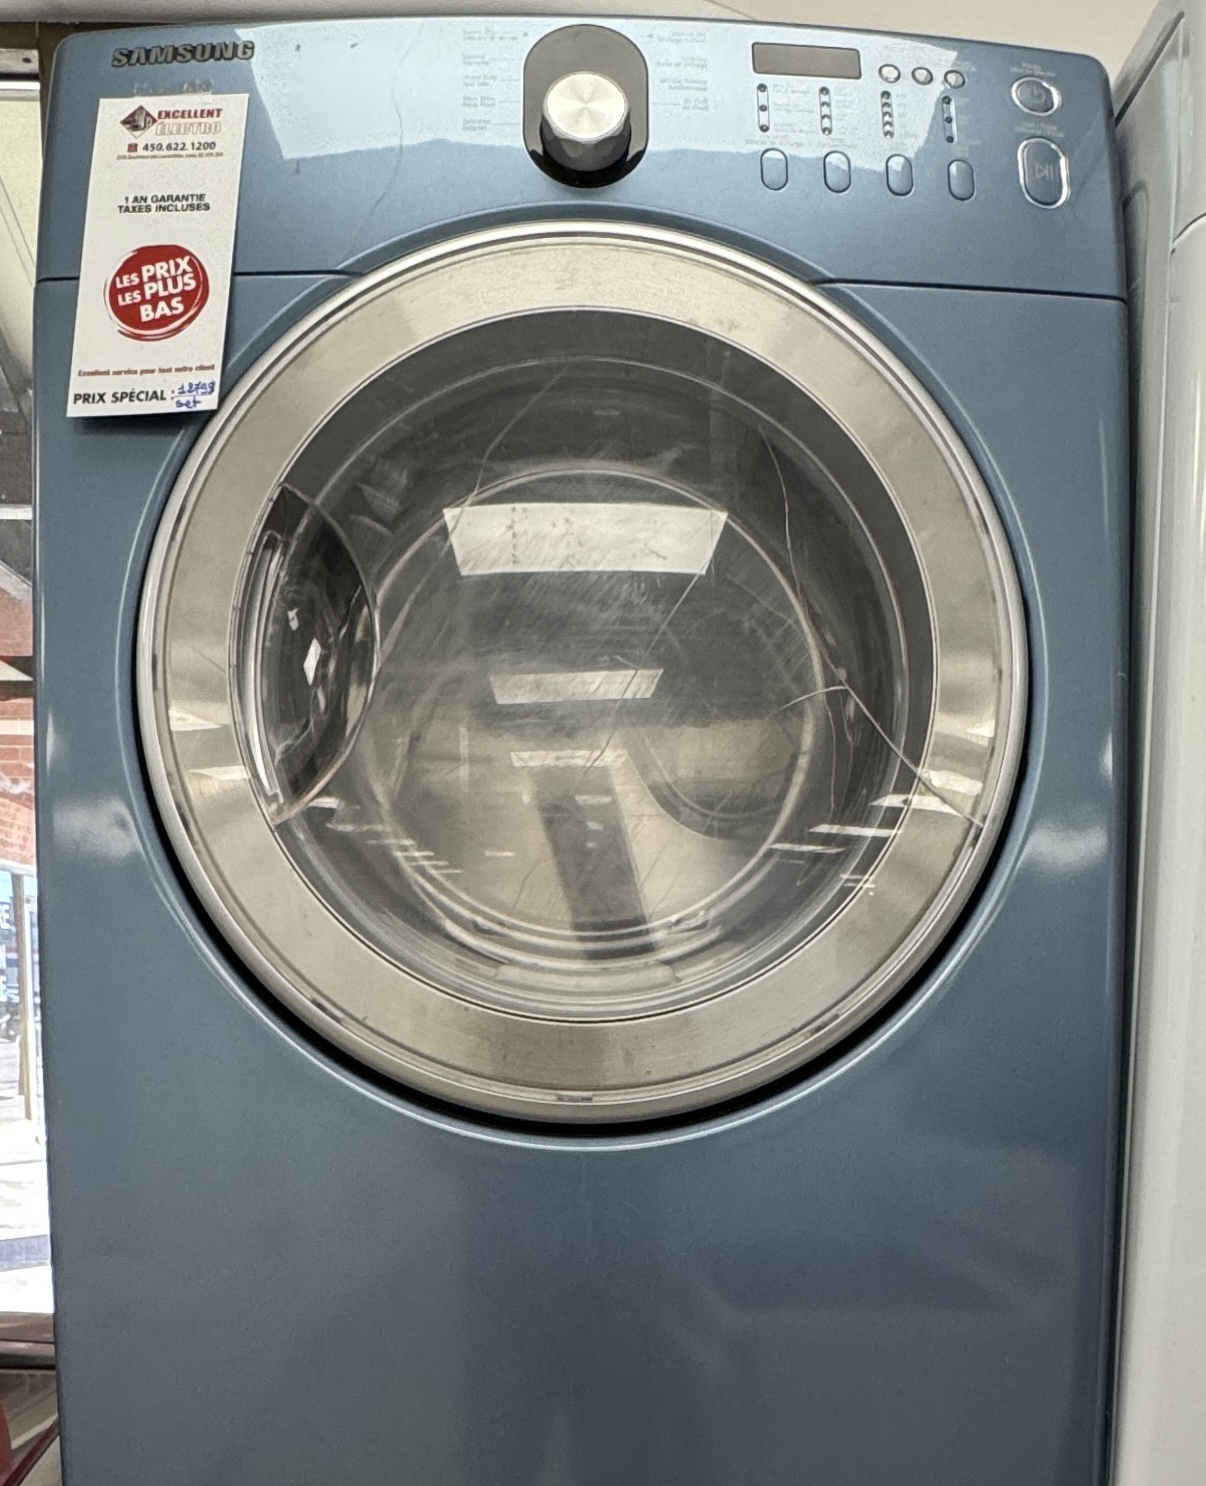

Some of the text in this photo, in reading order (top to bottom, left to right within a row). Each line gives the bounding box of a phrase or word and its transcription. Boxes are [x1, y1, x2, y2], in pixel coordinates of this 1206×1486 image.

[112, 41, 254, 67] SAMSUNG
[157, 108, 223, 119] EXCELLENT
[142, 141, 216, 152] 450.622.1200
[124, 193, 206, 205] 1 AN GARANTIE
[117, 202, 211, 214] TAXES INCLUSES
[115, 256, 193, 289] LES PRIX
[117, 273, 197, 307] LES PLUS
[139, 297, 184, 322] BAS
[73, 392, 106, 405] PRIX
[111, 388, 167, 404] SPÉCIAL
